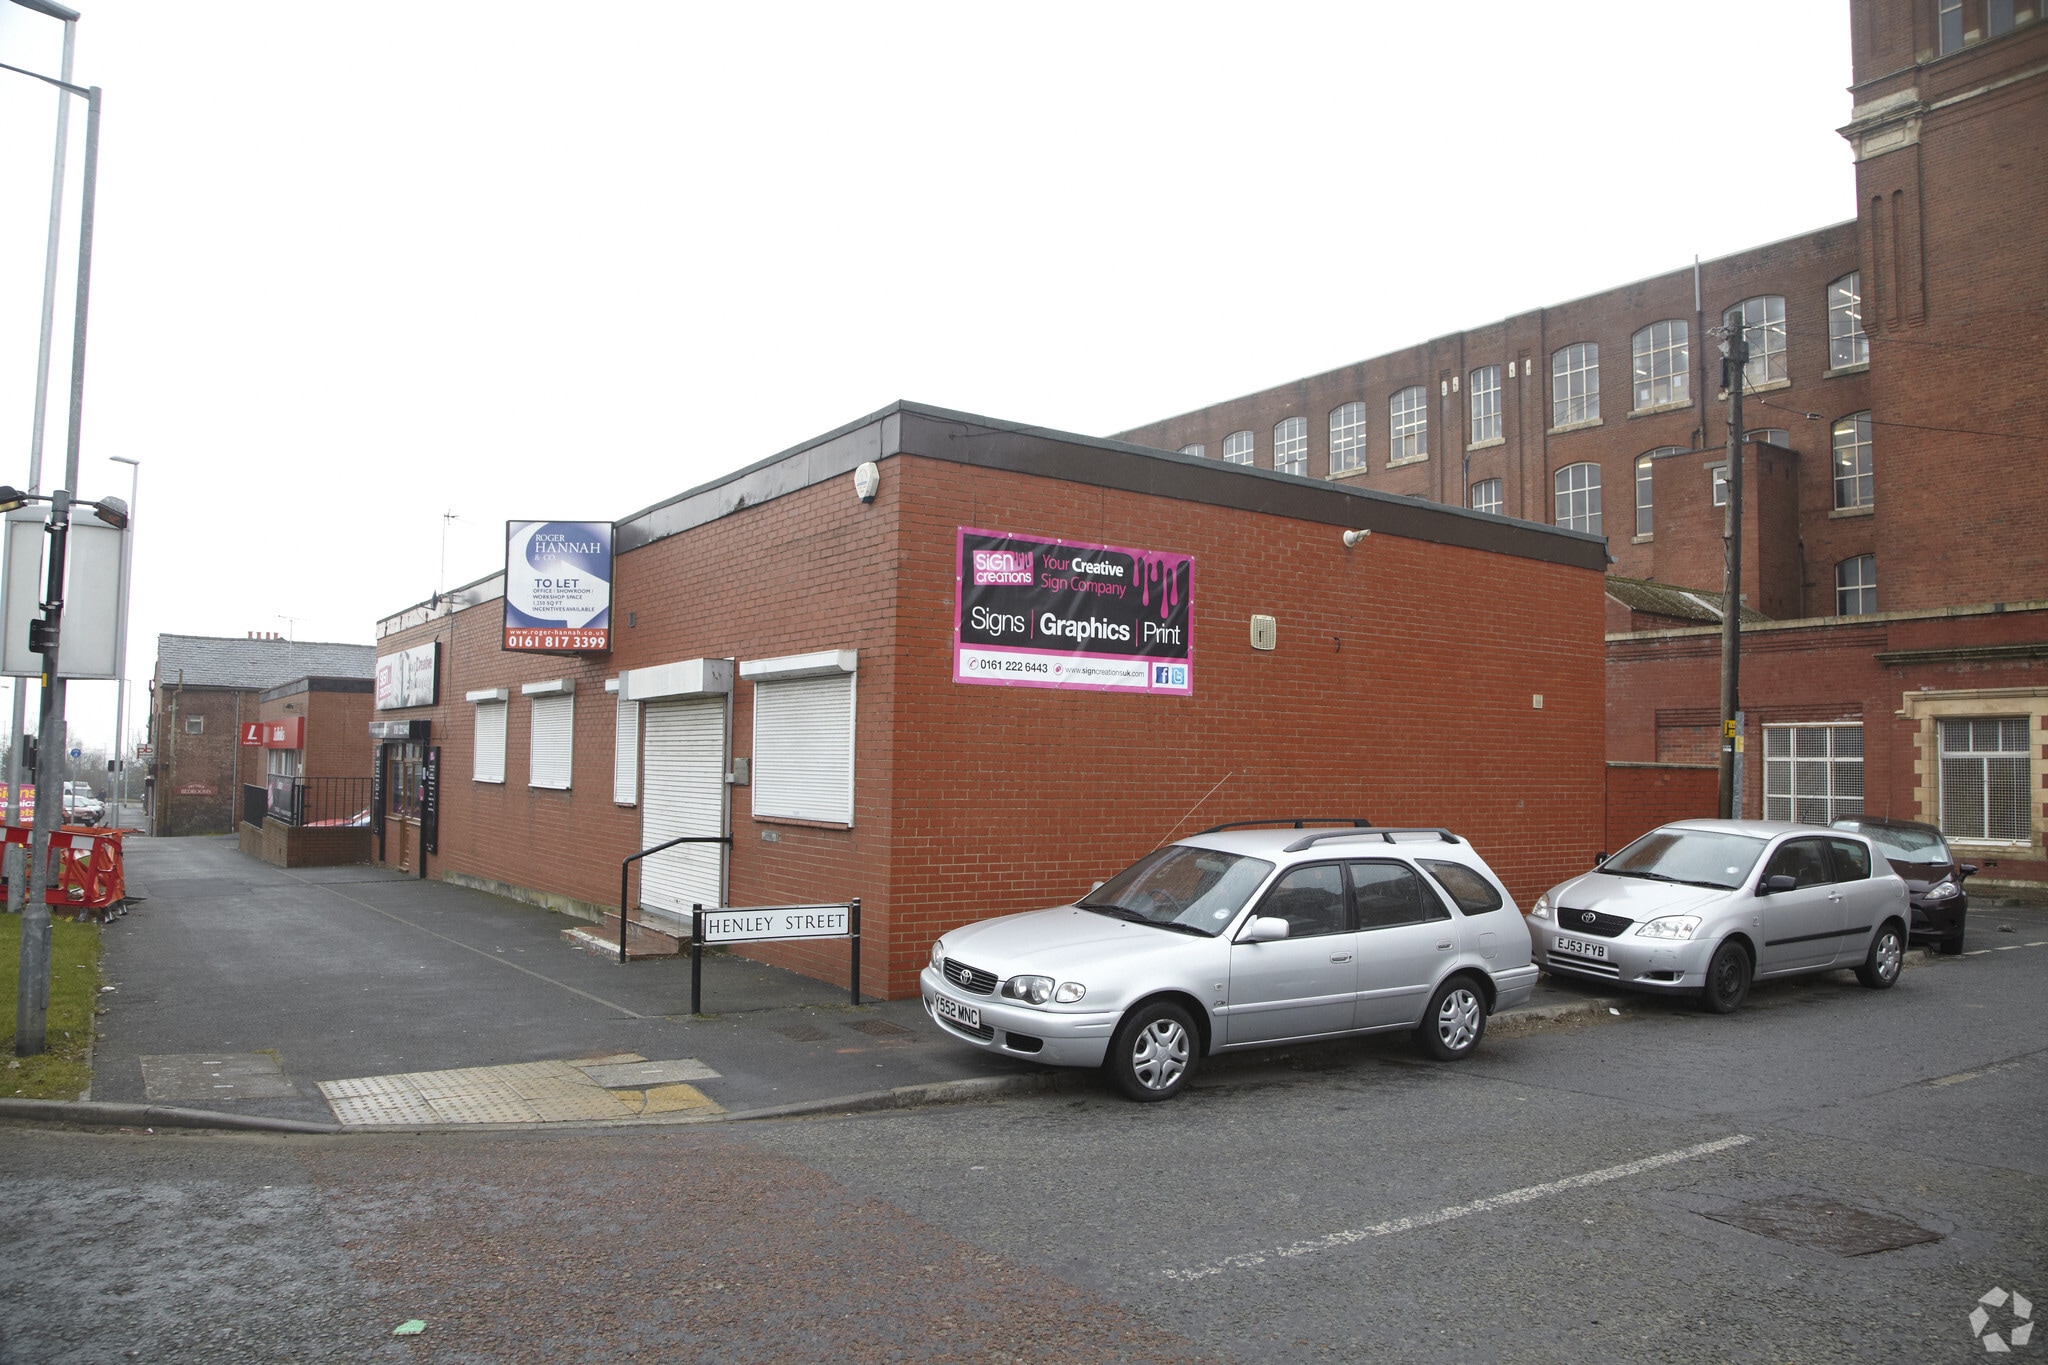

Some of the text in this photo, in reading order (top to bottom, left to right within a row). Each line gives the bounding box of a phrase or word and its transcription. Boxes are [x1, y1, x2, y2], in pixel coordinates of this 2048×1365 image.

[534, 553, 540, 561] &
[535, 543, 600, 553] HANNAH
[1041, 554, 1124, 577] Your Creative
[534, 579, 580, 589] TO LET
[976, 572, 1032, 584] creations
[1041, 574, 1127, 599] Sign Company
[970, 606, 1181, 645] Signs Graphics Print
[508, 635, 606, 649] 0161 817 3399
[980, 659, 1003, 671] 0161
[1005, 661, 1023, 673] 222
[1025, 662, 1048, 674] 6443
[1065, 666, 1145, 678] www.signcreationsuk.com
[708, 914, 846, 934] HENLEY STREET
[1558, 938, 1604, 957] EJ53 FYB
[934, 992, 978, 1026] Y552 MNC
